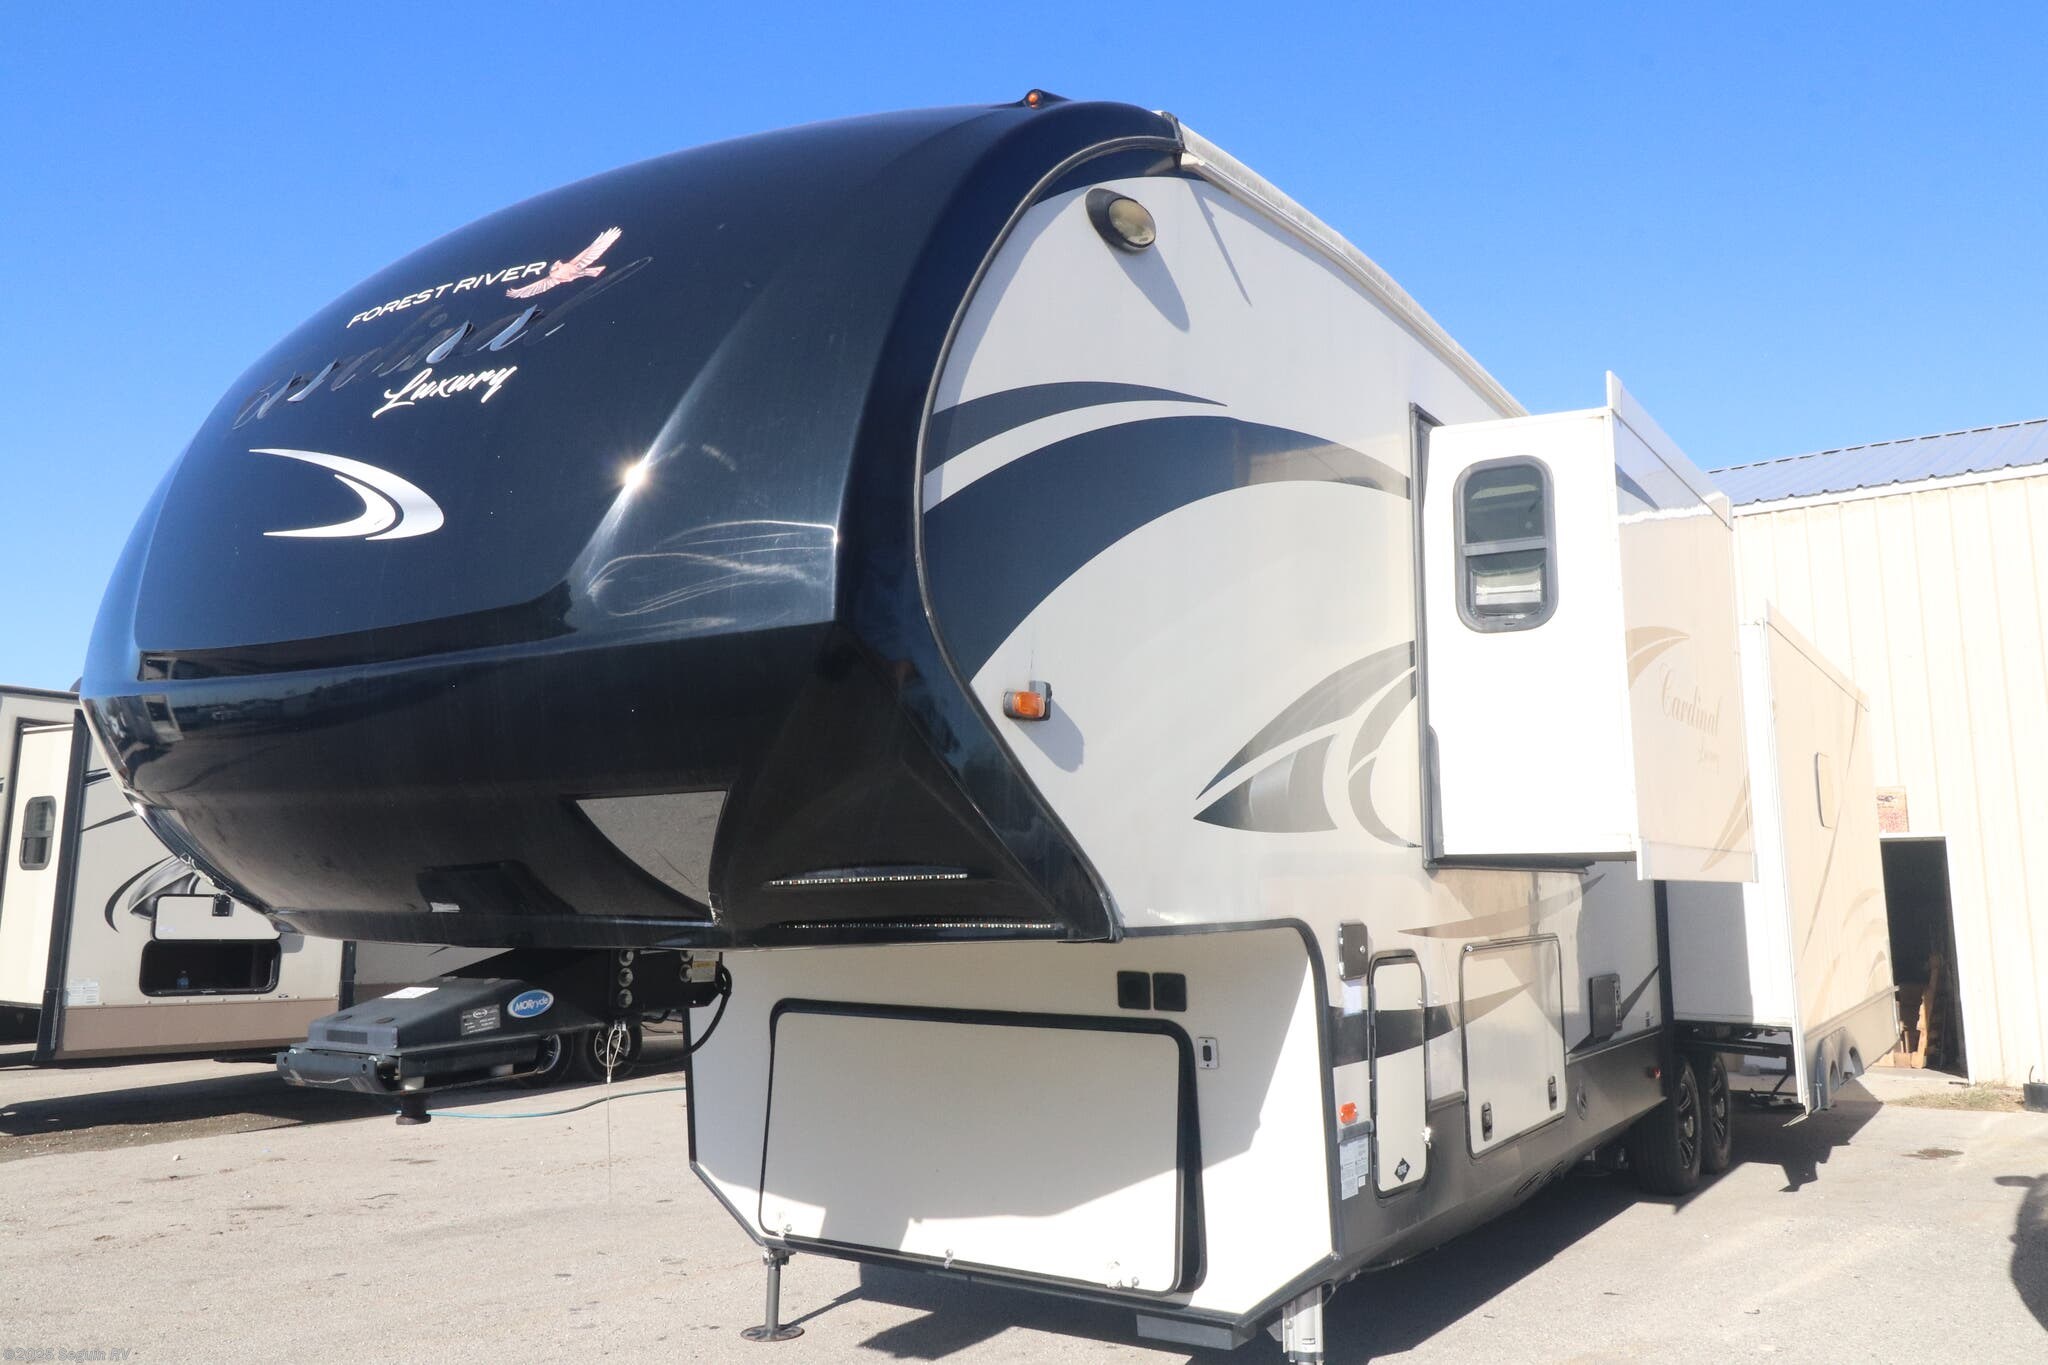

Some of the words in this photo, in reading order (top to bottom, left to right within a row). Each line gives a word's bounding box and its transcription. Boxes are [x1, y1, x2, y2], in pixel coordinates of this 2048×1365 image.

[346, 282, 454, 329] FOREST
[452, 261, 547, 294] RIVER
[372, 366, 518, 419] Luxury
[1656, 662, 1723, 737] Cardinal
